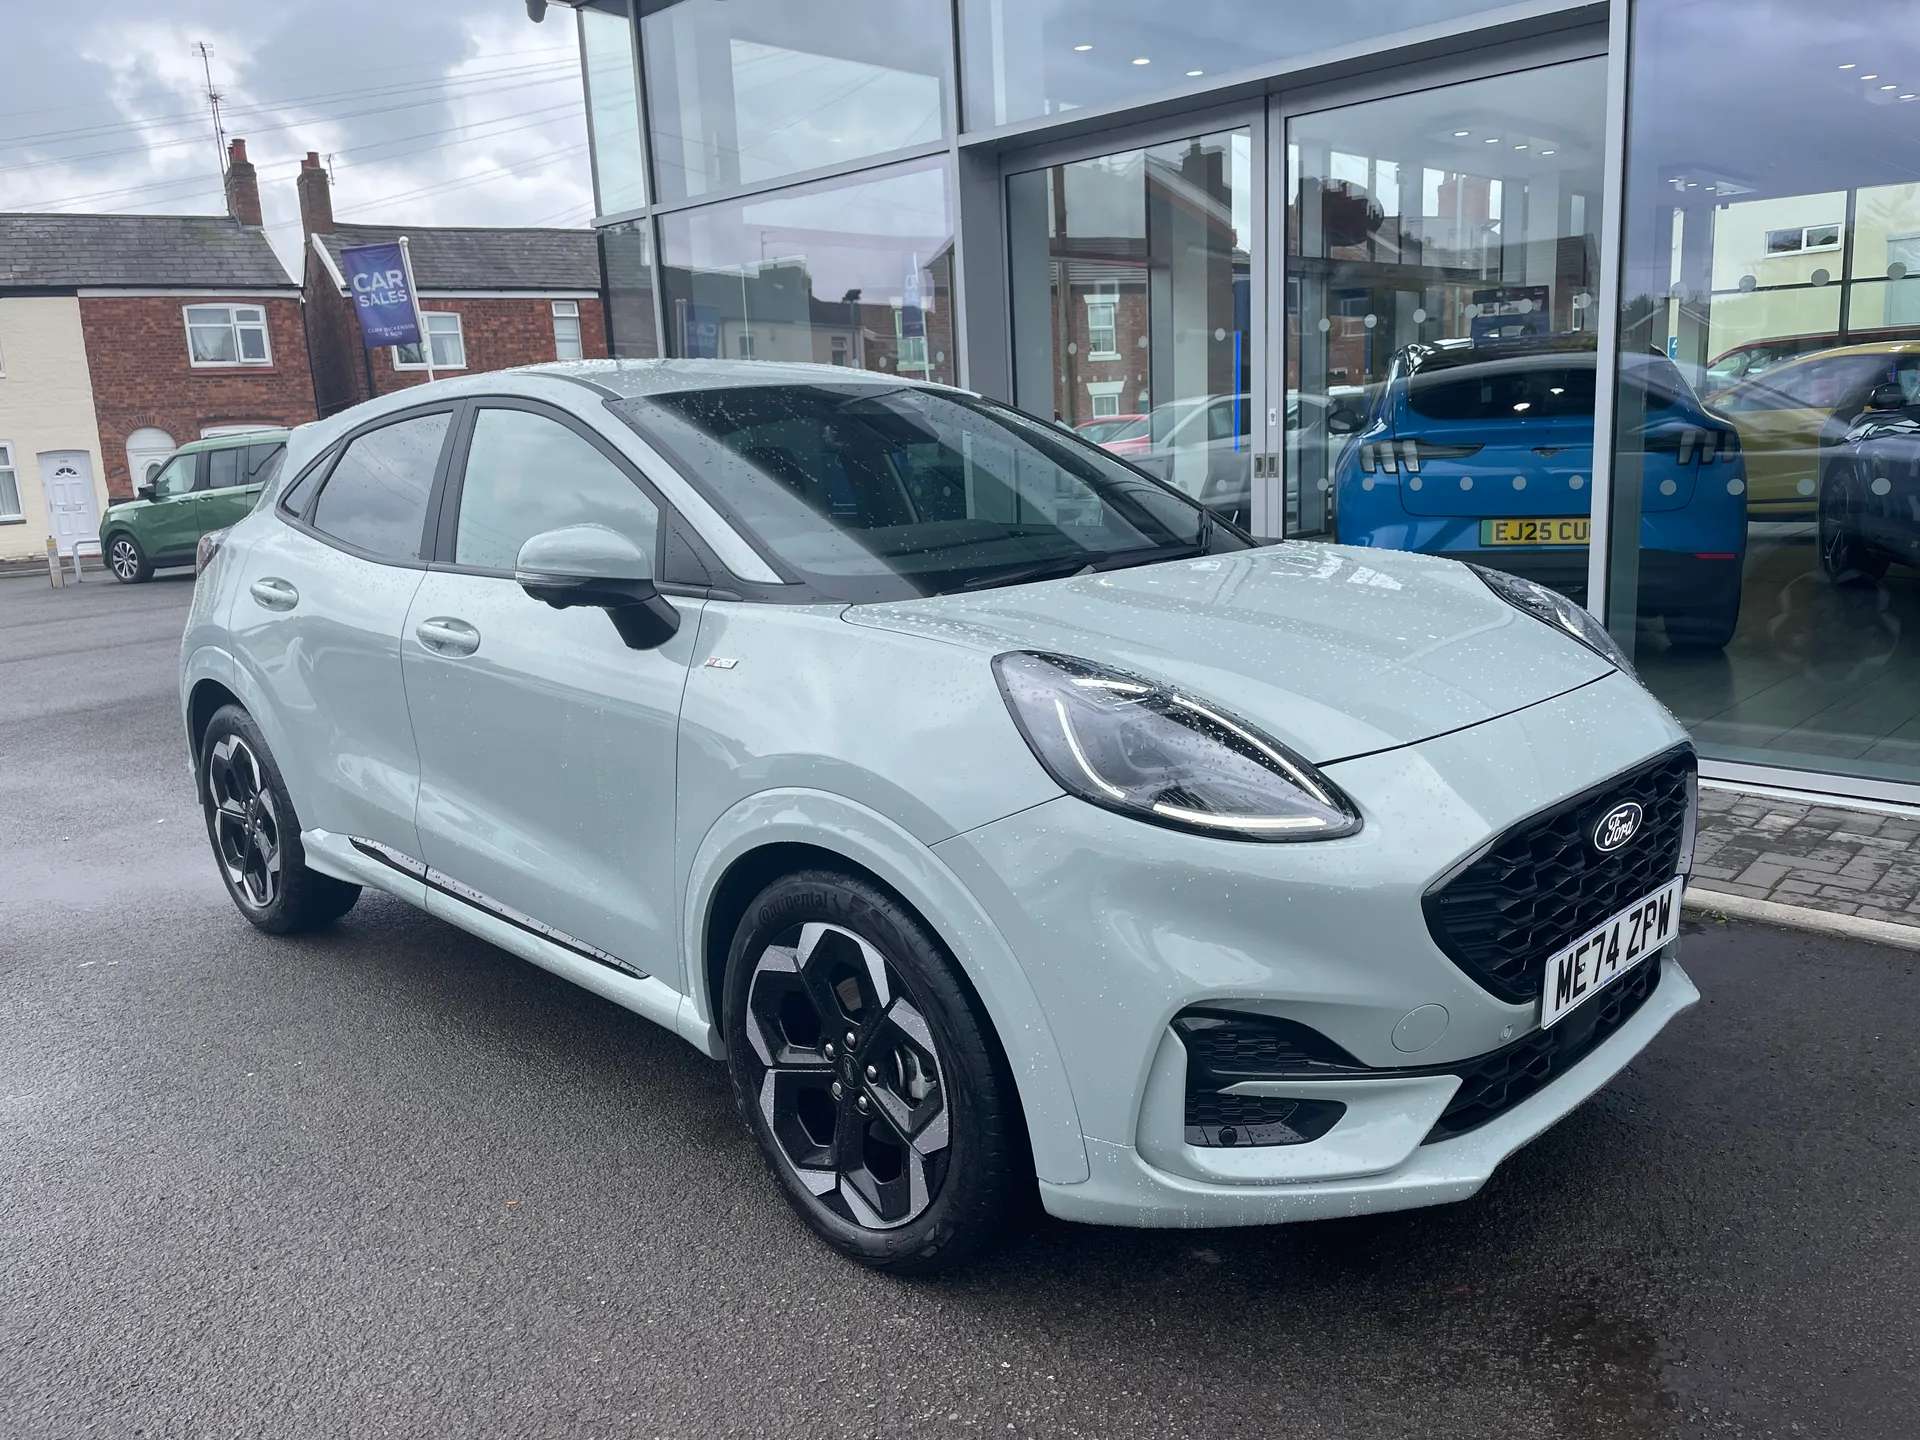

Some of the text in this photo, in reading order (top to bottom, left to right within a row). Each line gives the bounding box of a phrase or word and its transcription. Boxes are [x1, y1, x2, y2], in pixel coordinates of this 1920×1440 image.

[353, 270, 404, 292] CAR
[359, 290, 408, 307] SALES
[1495, 522, 1591, 541] EJ25 CU
[1604, 809, 1635, 846] Ford
[759, 891, 829, 922] Continental
[1555, 889, 1673, 1011] ME74 ZPW
